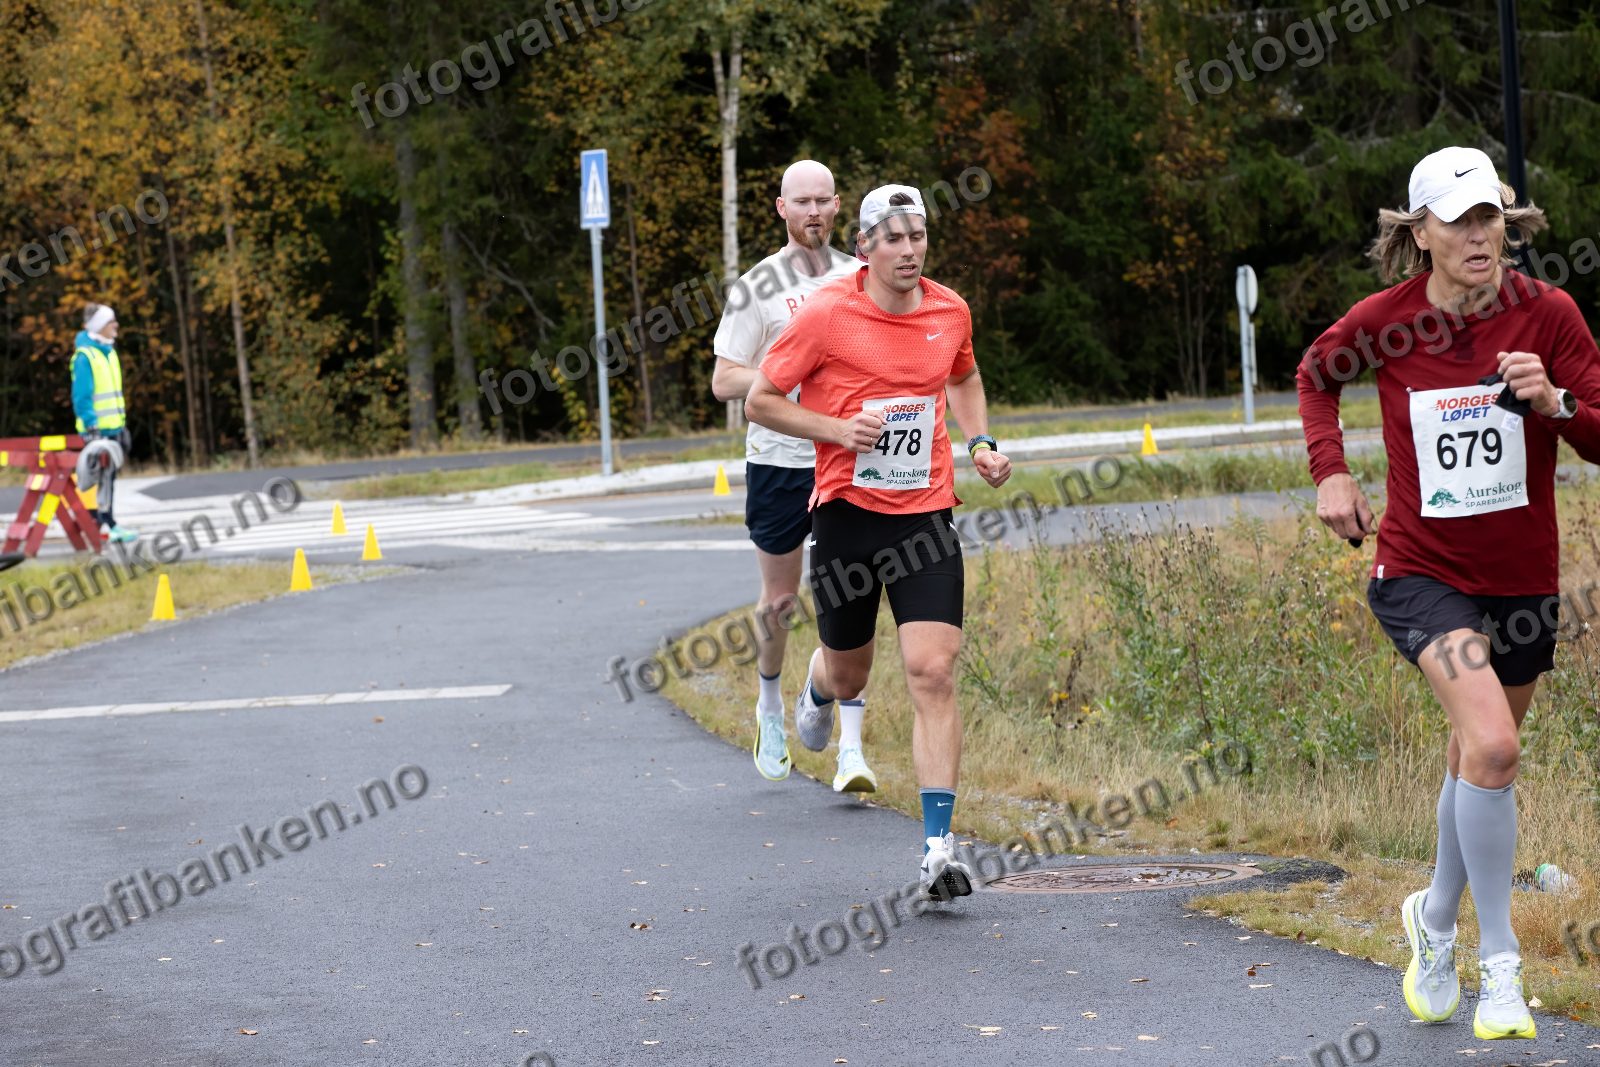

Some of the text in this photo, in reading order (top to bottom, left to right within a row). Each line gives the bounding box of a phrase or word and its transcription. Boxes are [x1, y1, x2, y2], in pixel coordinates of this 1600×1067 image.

[883, 403, 926, 414] NORGES
[1435, 393, 1500, 410] NORGES
[885, 412, 919, 422] LØPET
[1441, 406, 1492, 422] LØPET
[875, 428, 922, 456] 478
[1437, 427, 1503, 470] 679
[888, 468, 928, 478] Aurskog
[1465, 481, 1522, 499] Aurskog
